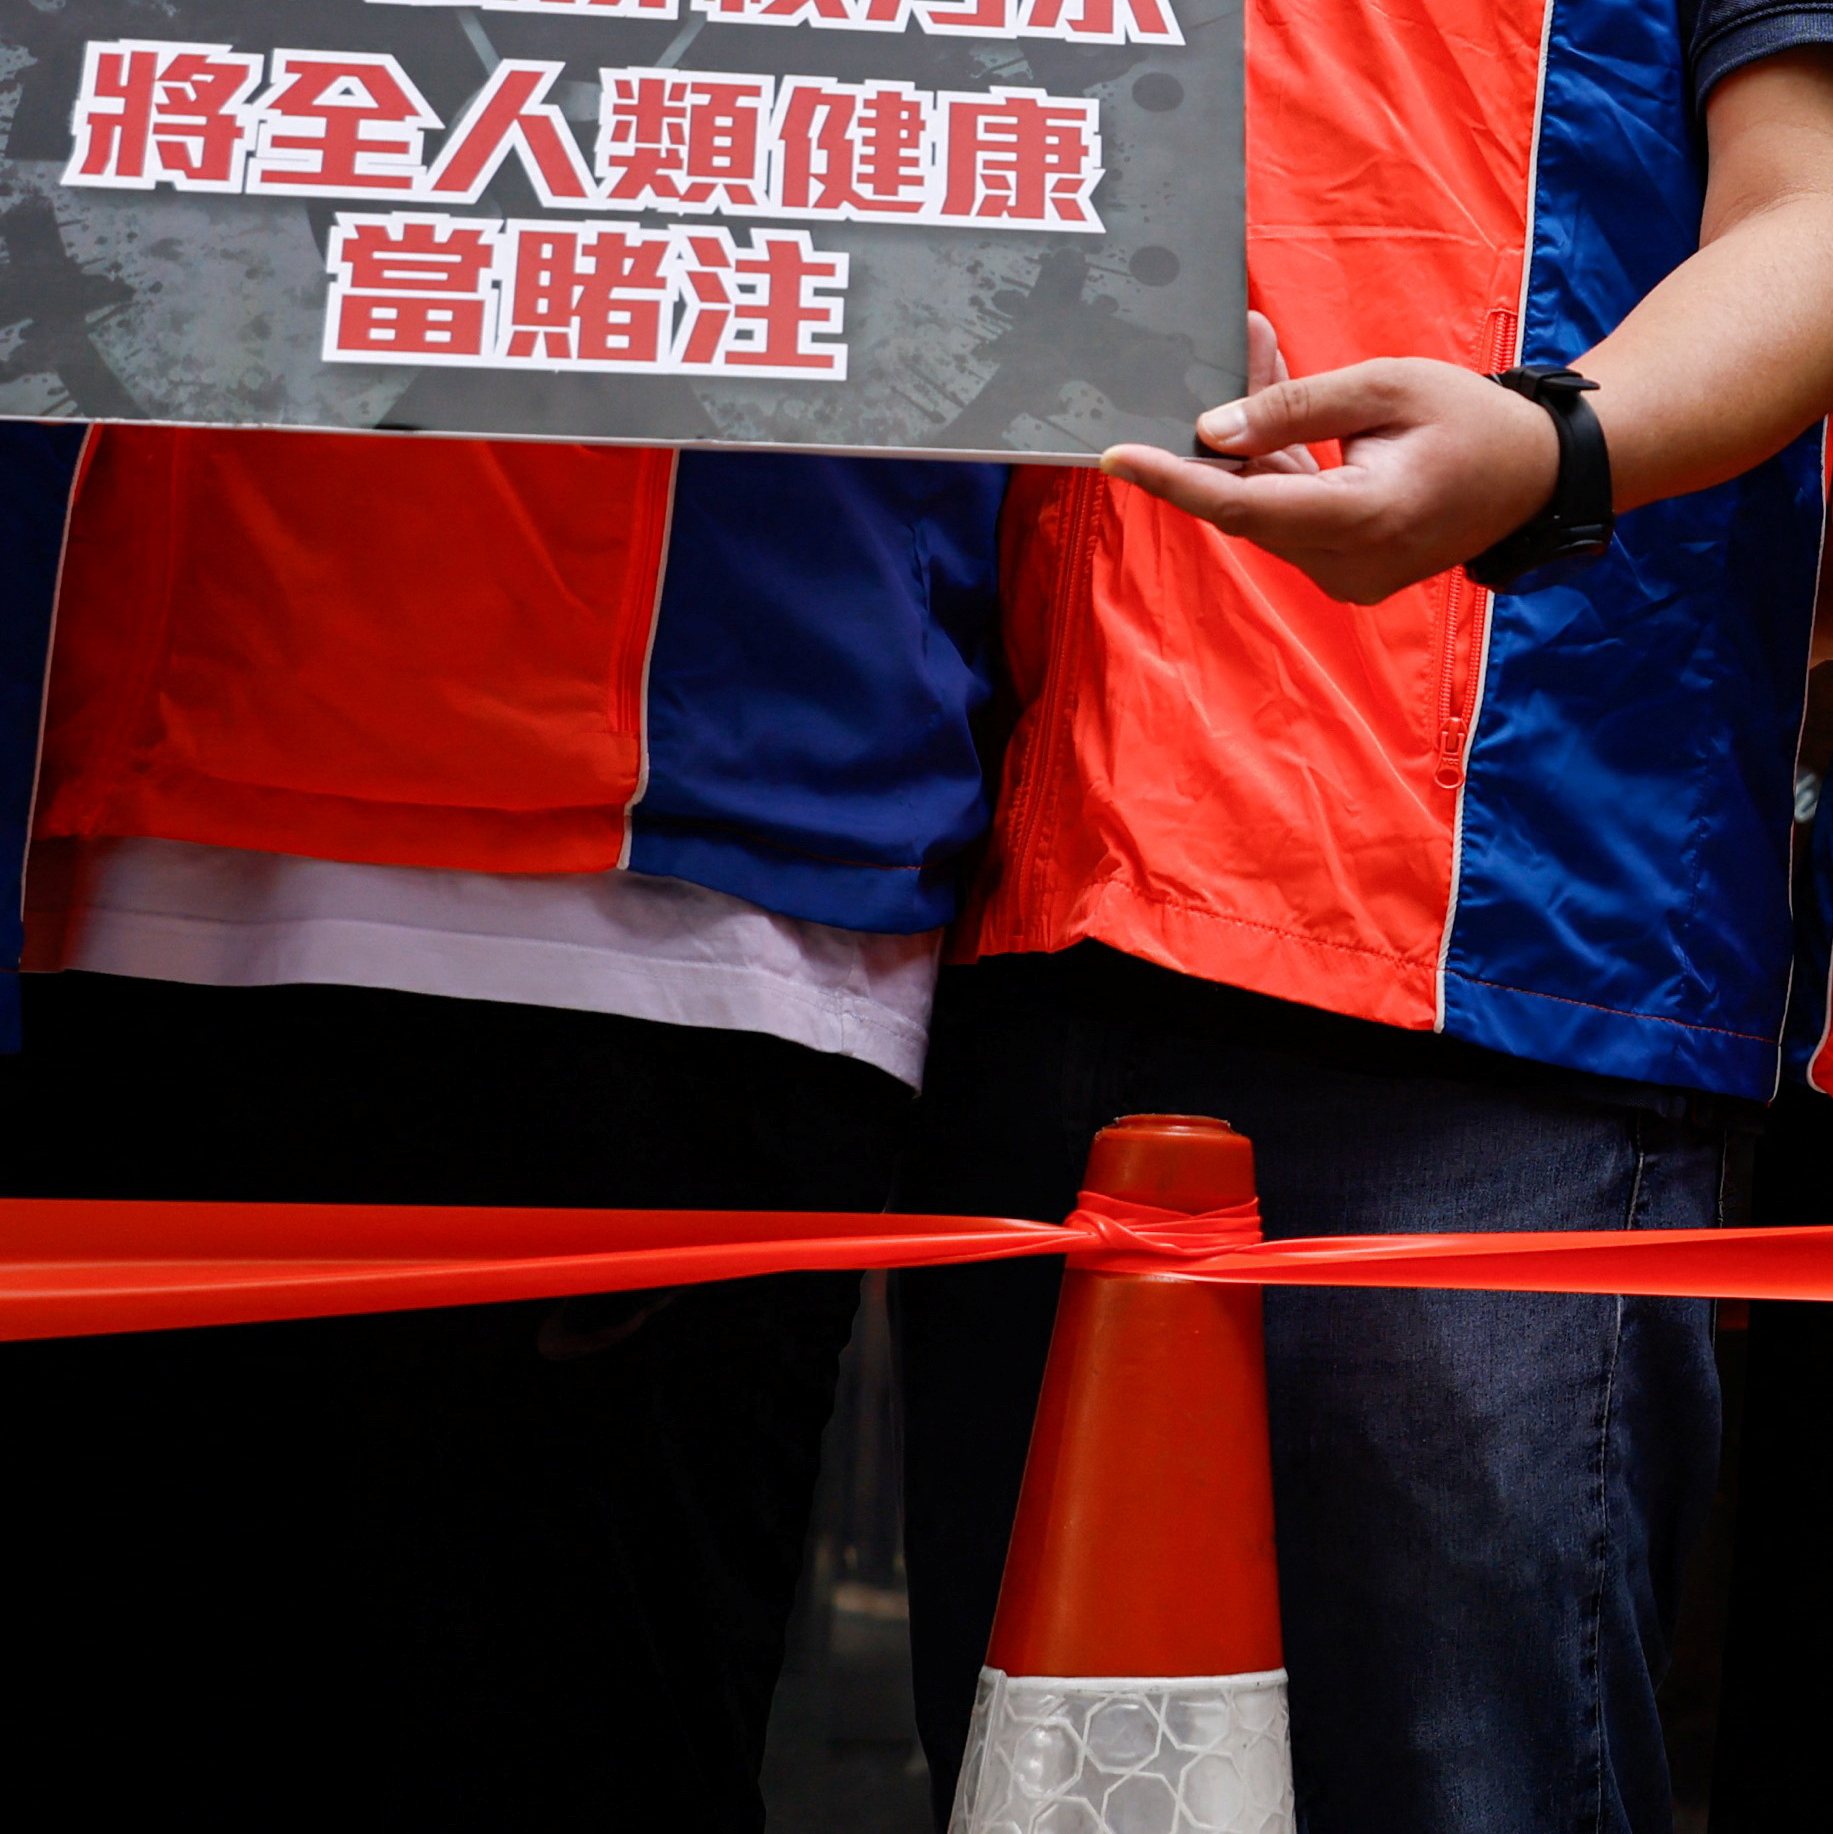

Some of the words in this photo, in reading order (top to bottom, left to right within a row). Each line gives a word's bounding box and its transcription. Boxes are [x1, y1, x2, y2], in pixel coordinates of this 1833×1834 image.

[63, 43, 1105, 231] 將全人類健康
[325, 214, 847, 377] 當賭注
